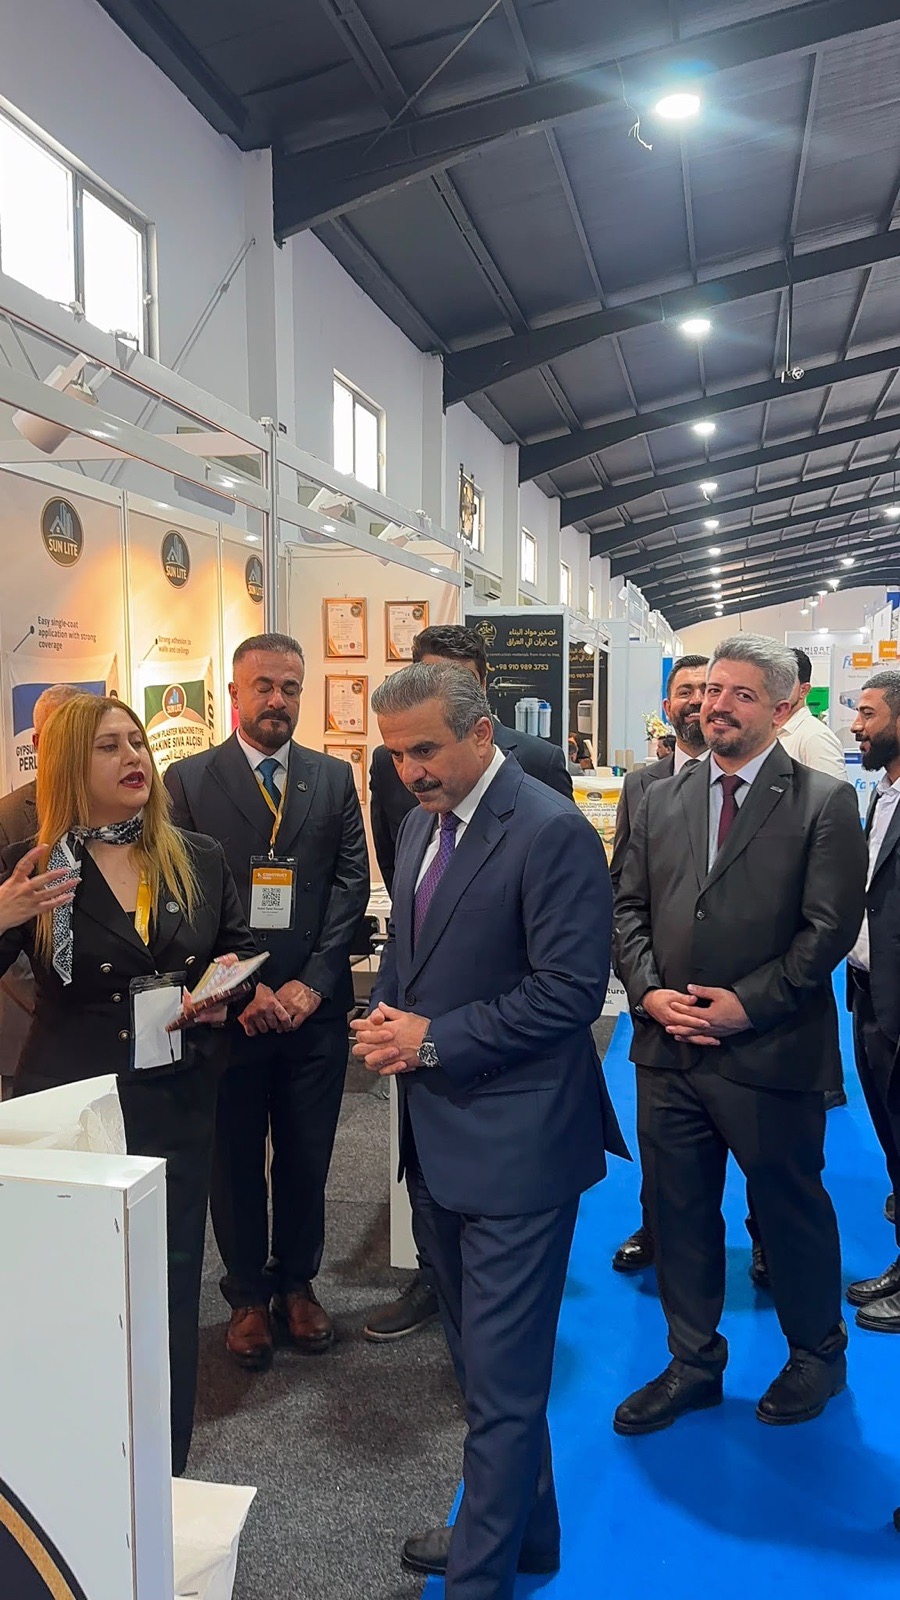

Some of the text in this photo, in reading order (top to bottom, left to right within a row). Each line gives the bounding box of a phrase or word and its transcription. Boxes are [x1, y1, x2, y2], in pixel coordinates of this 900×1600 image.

[48, 538, 78, 556] SUN LITE
[166, 564, 187, 580] SUN LITE
[248, 584, 256, 596] SUN
[38, 616, 78, 629] Easy single-coat
[38, 629, 68, 639] application
[80, 634, 96, 642] strong
[508, 628, 556, 637] تصدير مواد البناء
[38, 641, 62, 651] coverage
[158, 635, 170, 645] Strong
[162, 728, 178, 738] PLASTER
[178, 726, 195, 734] MACHINE
[196, 726, 204, 736] TYPE
[150, 738, 171, 752] MAKINE
[172, 736, 185, 748] SIVA
[20, 756, 38, 772] PERL
